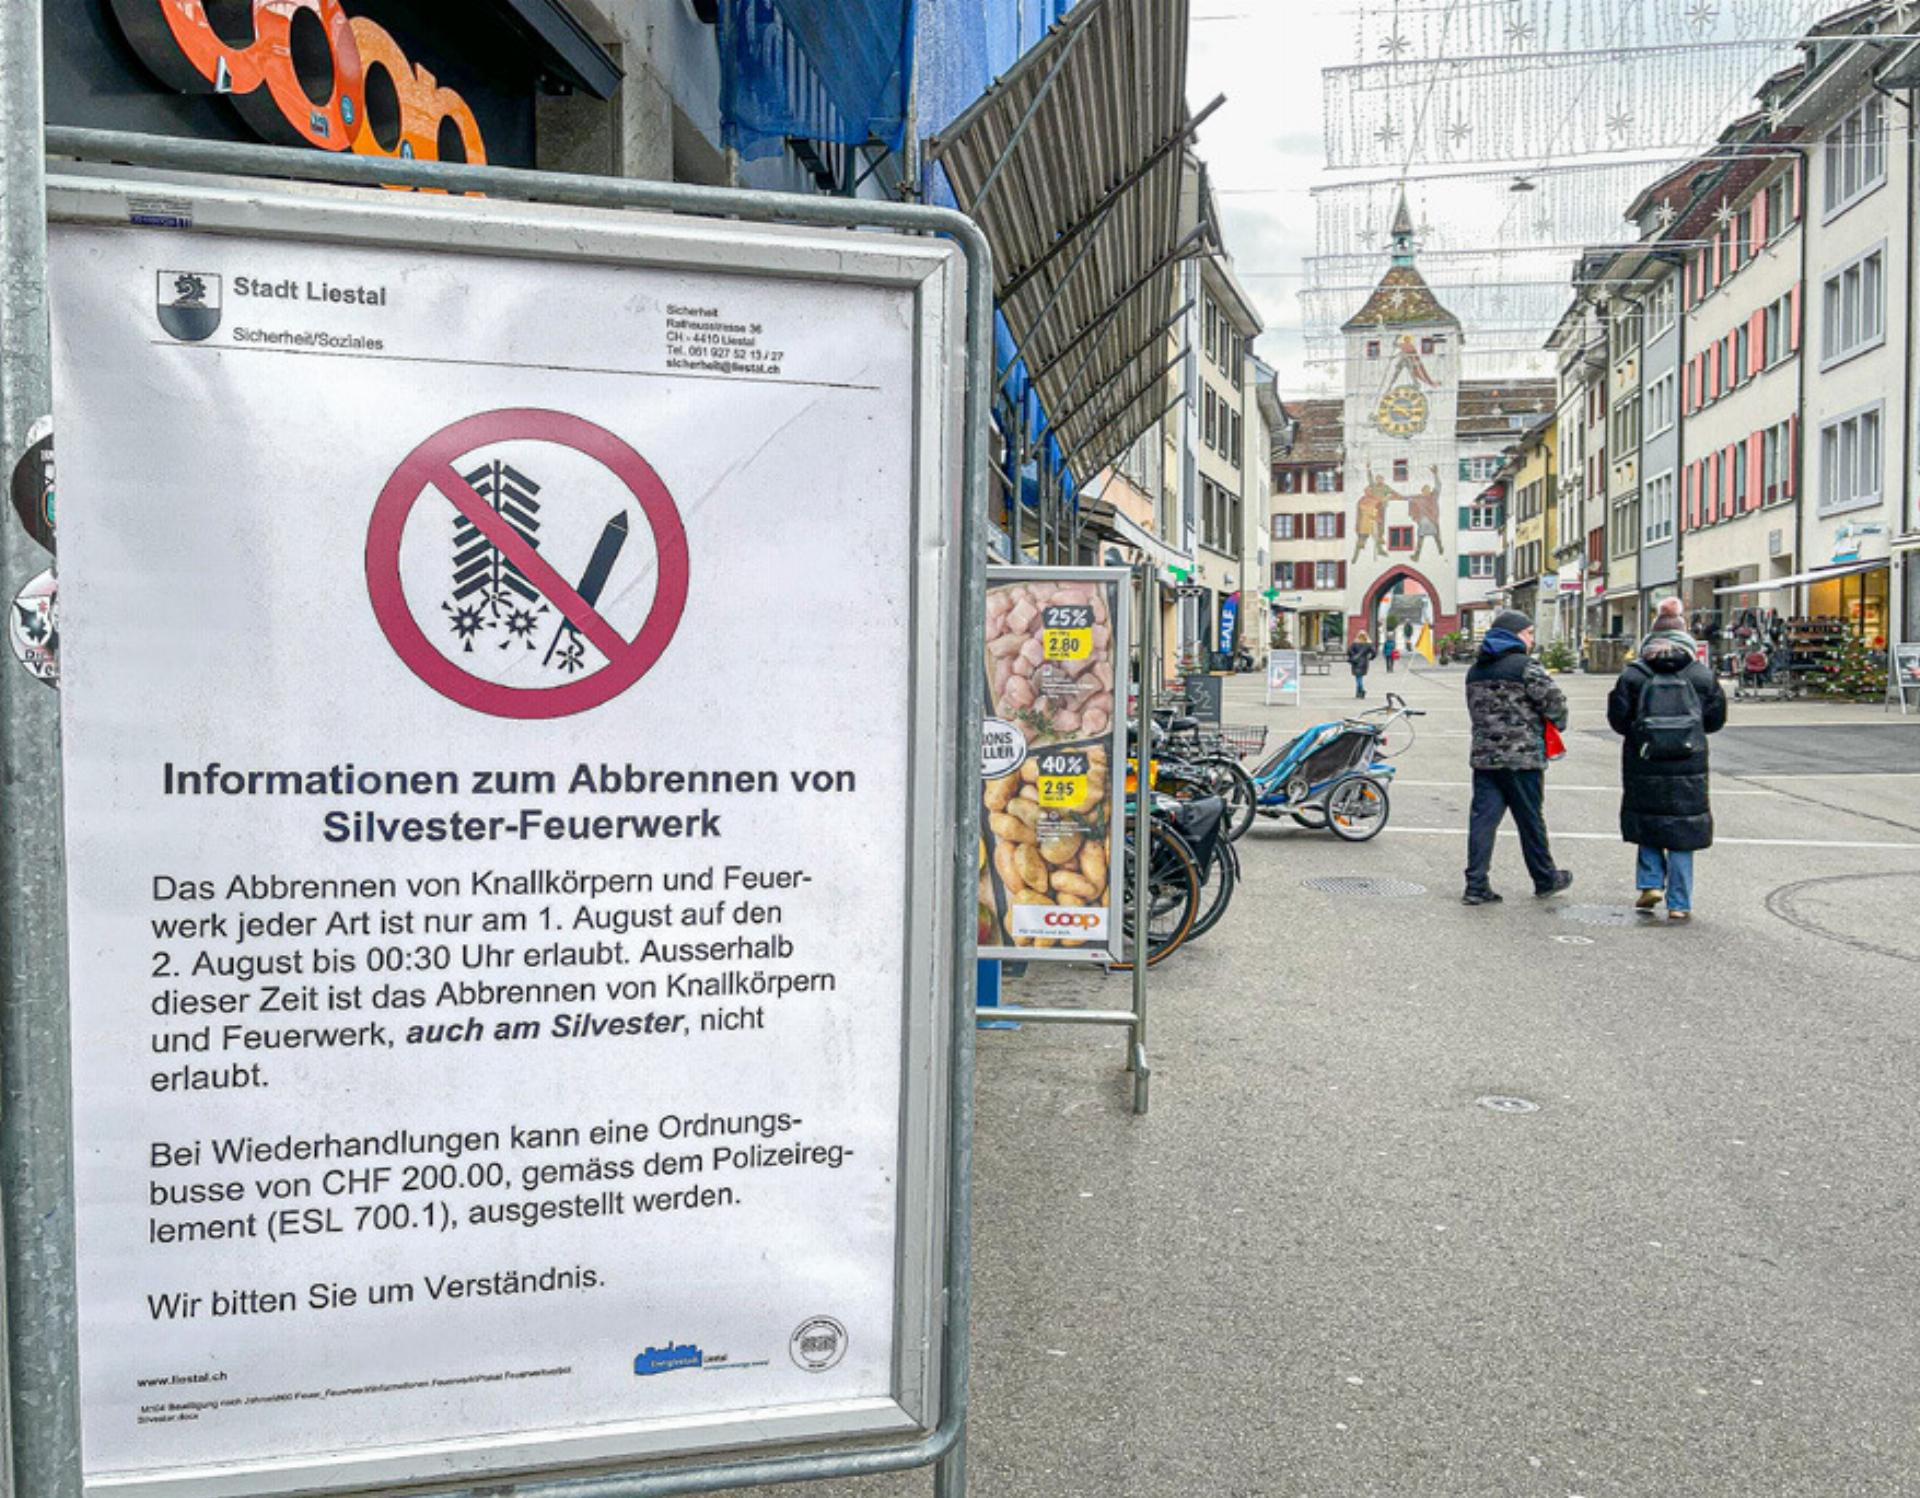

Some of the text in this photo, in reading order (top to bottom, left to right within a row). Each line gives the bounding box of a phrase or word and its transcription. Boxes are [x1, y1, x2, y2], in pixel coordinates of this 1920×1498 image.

[233, 276, 387, 306] Stadt Liestal
[666, 304, 719, 317] Sicherheit
[232, 327, 385, 350] Sicherheit/Soziales
[666, 331, 683, 342] CH
[693, 333, 720, 344] 4410
[721, 335, 755, 346] Liestal
[710, 347, 731, 358] 927
[771, 351, 784, 361] 27
[666, 359, 781, 374] sicherheit@liestal.ch
[1047, 607, 1088, 626] 25%
[1048, 638, 1080, 653] 2.80
[163, 761, 856, 796] Informationen zum Abbrennen von
[1042, 755, 1083, 774] 40%
[322, 807, 722, 844] Silvester-Feuerwerk
[152, 864, 813, 902] Das Abbrennen von Knallkörpern und Feuer-
[150, 899, 782, 945] werk jeder Art ist nur am 1. August auf den
[1044, 911, 1101, 930] coop
[151, 933, 795, 983] 2. August bis 00:30 Uhr erlaubt. Ausserhalb
[150, 970, 836, 1016] dieser Zeit ist das Abbrennen von Knallkörpern
[151, 1005, 765, 1054] und Feuerwerk, auch am Silvester, nicht
[150, 1062, 270, 1093] erlaubt.
[149, 1112, 803, 1169] Bei Wiederhandlungen kann eine Ordnungs-
[149, 1141, 855, 1206] busse von CHF 200.00, gemäss dem Polizeireg-
[149, 1183, 742, 1244] lement (ESL 700.1), ausgestellt werden.
[146, 1264, 605, 1321] Wir bitten Sie um Verständnis.
[137, 1372, 228, 1388] www.liestal.ch
